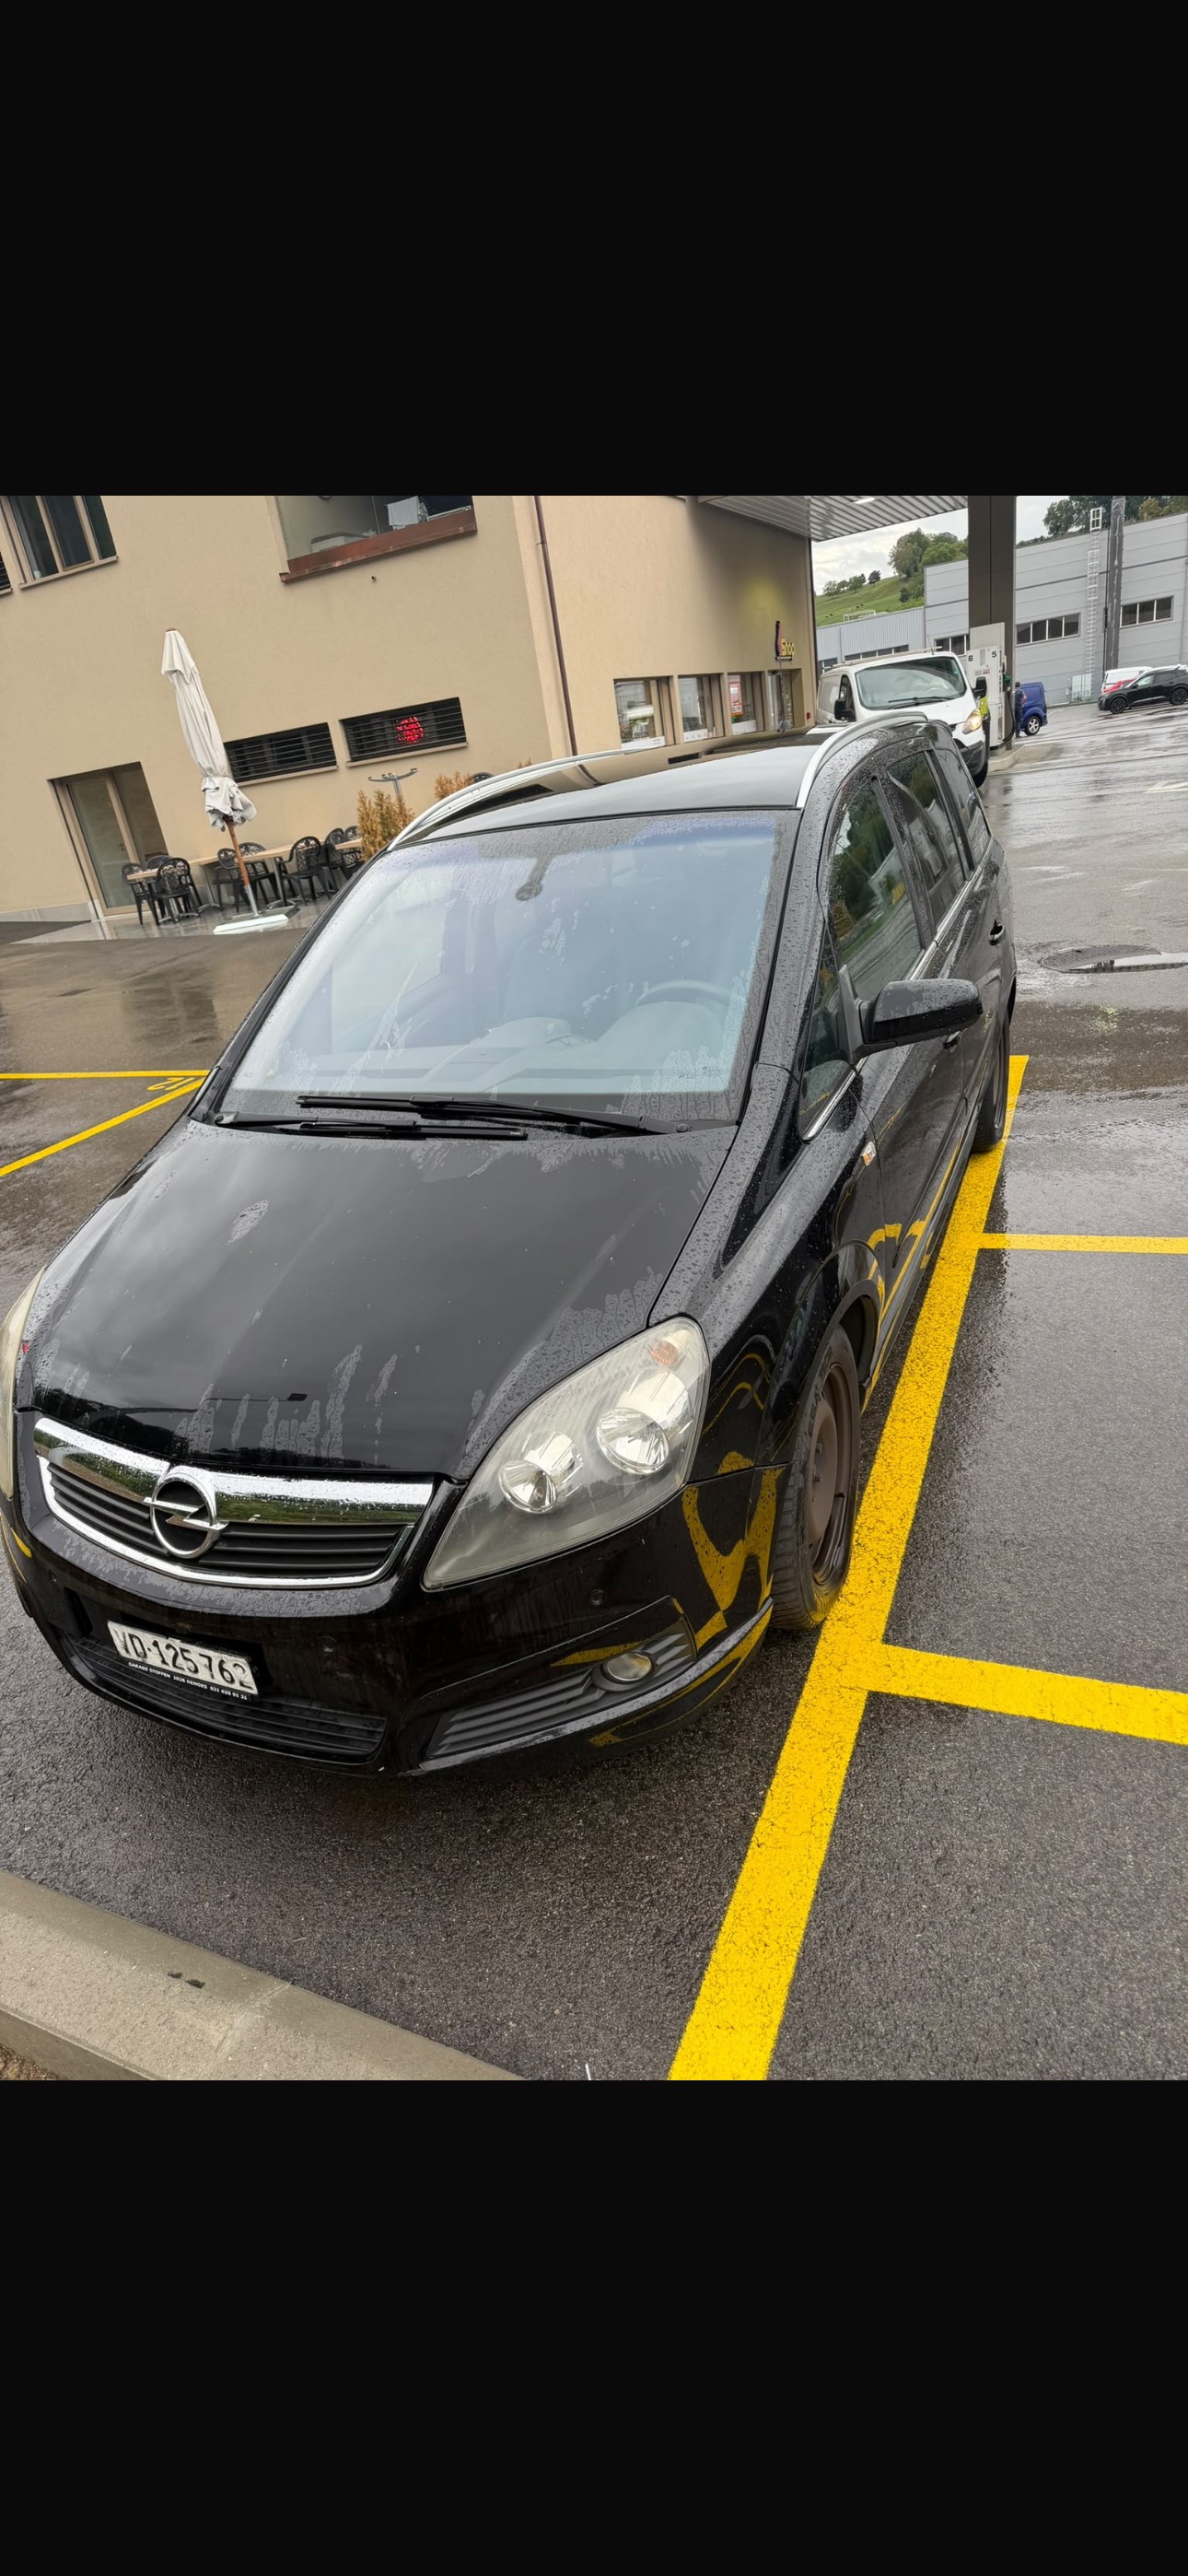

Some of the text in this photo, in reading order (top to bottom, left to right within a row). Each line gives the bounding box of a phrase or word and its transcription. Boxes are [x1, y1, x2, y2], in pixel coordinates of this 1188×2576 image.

[128, 1661, 148, 1672] GARAGE
[149, 1668, 171, 1679] STEFFEN
[186, 1679, 208, 1690] DENGES
